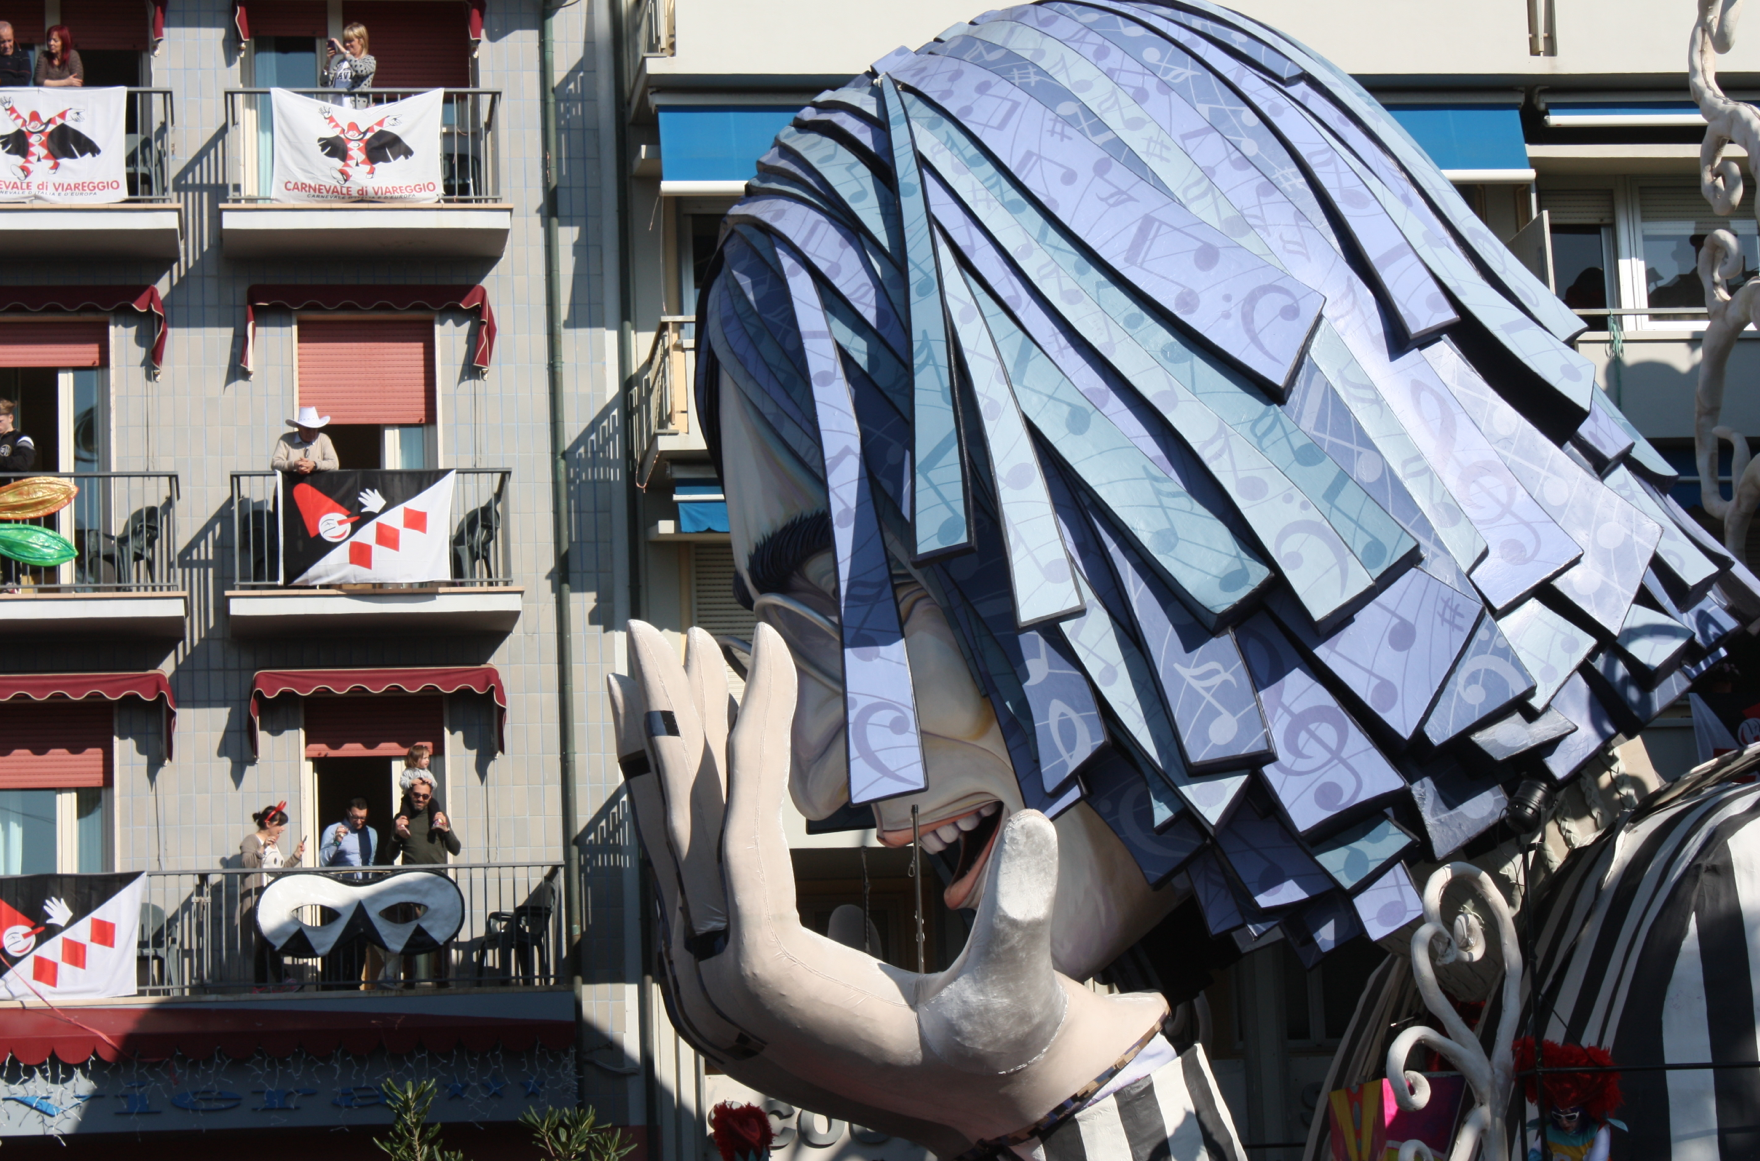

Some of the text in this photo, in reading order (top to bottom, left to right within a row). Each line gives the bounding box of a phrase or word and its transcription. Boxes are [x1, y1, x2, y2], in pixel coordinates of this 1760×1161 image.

[37, 181, 48, 191] di
[53, 180, 120, 192] VIAREGGIO
[284, 181, 437, 196] CARNEVALE di VIAREGGIO
